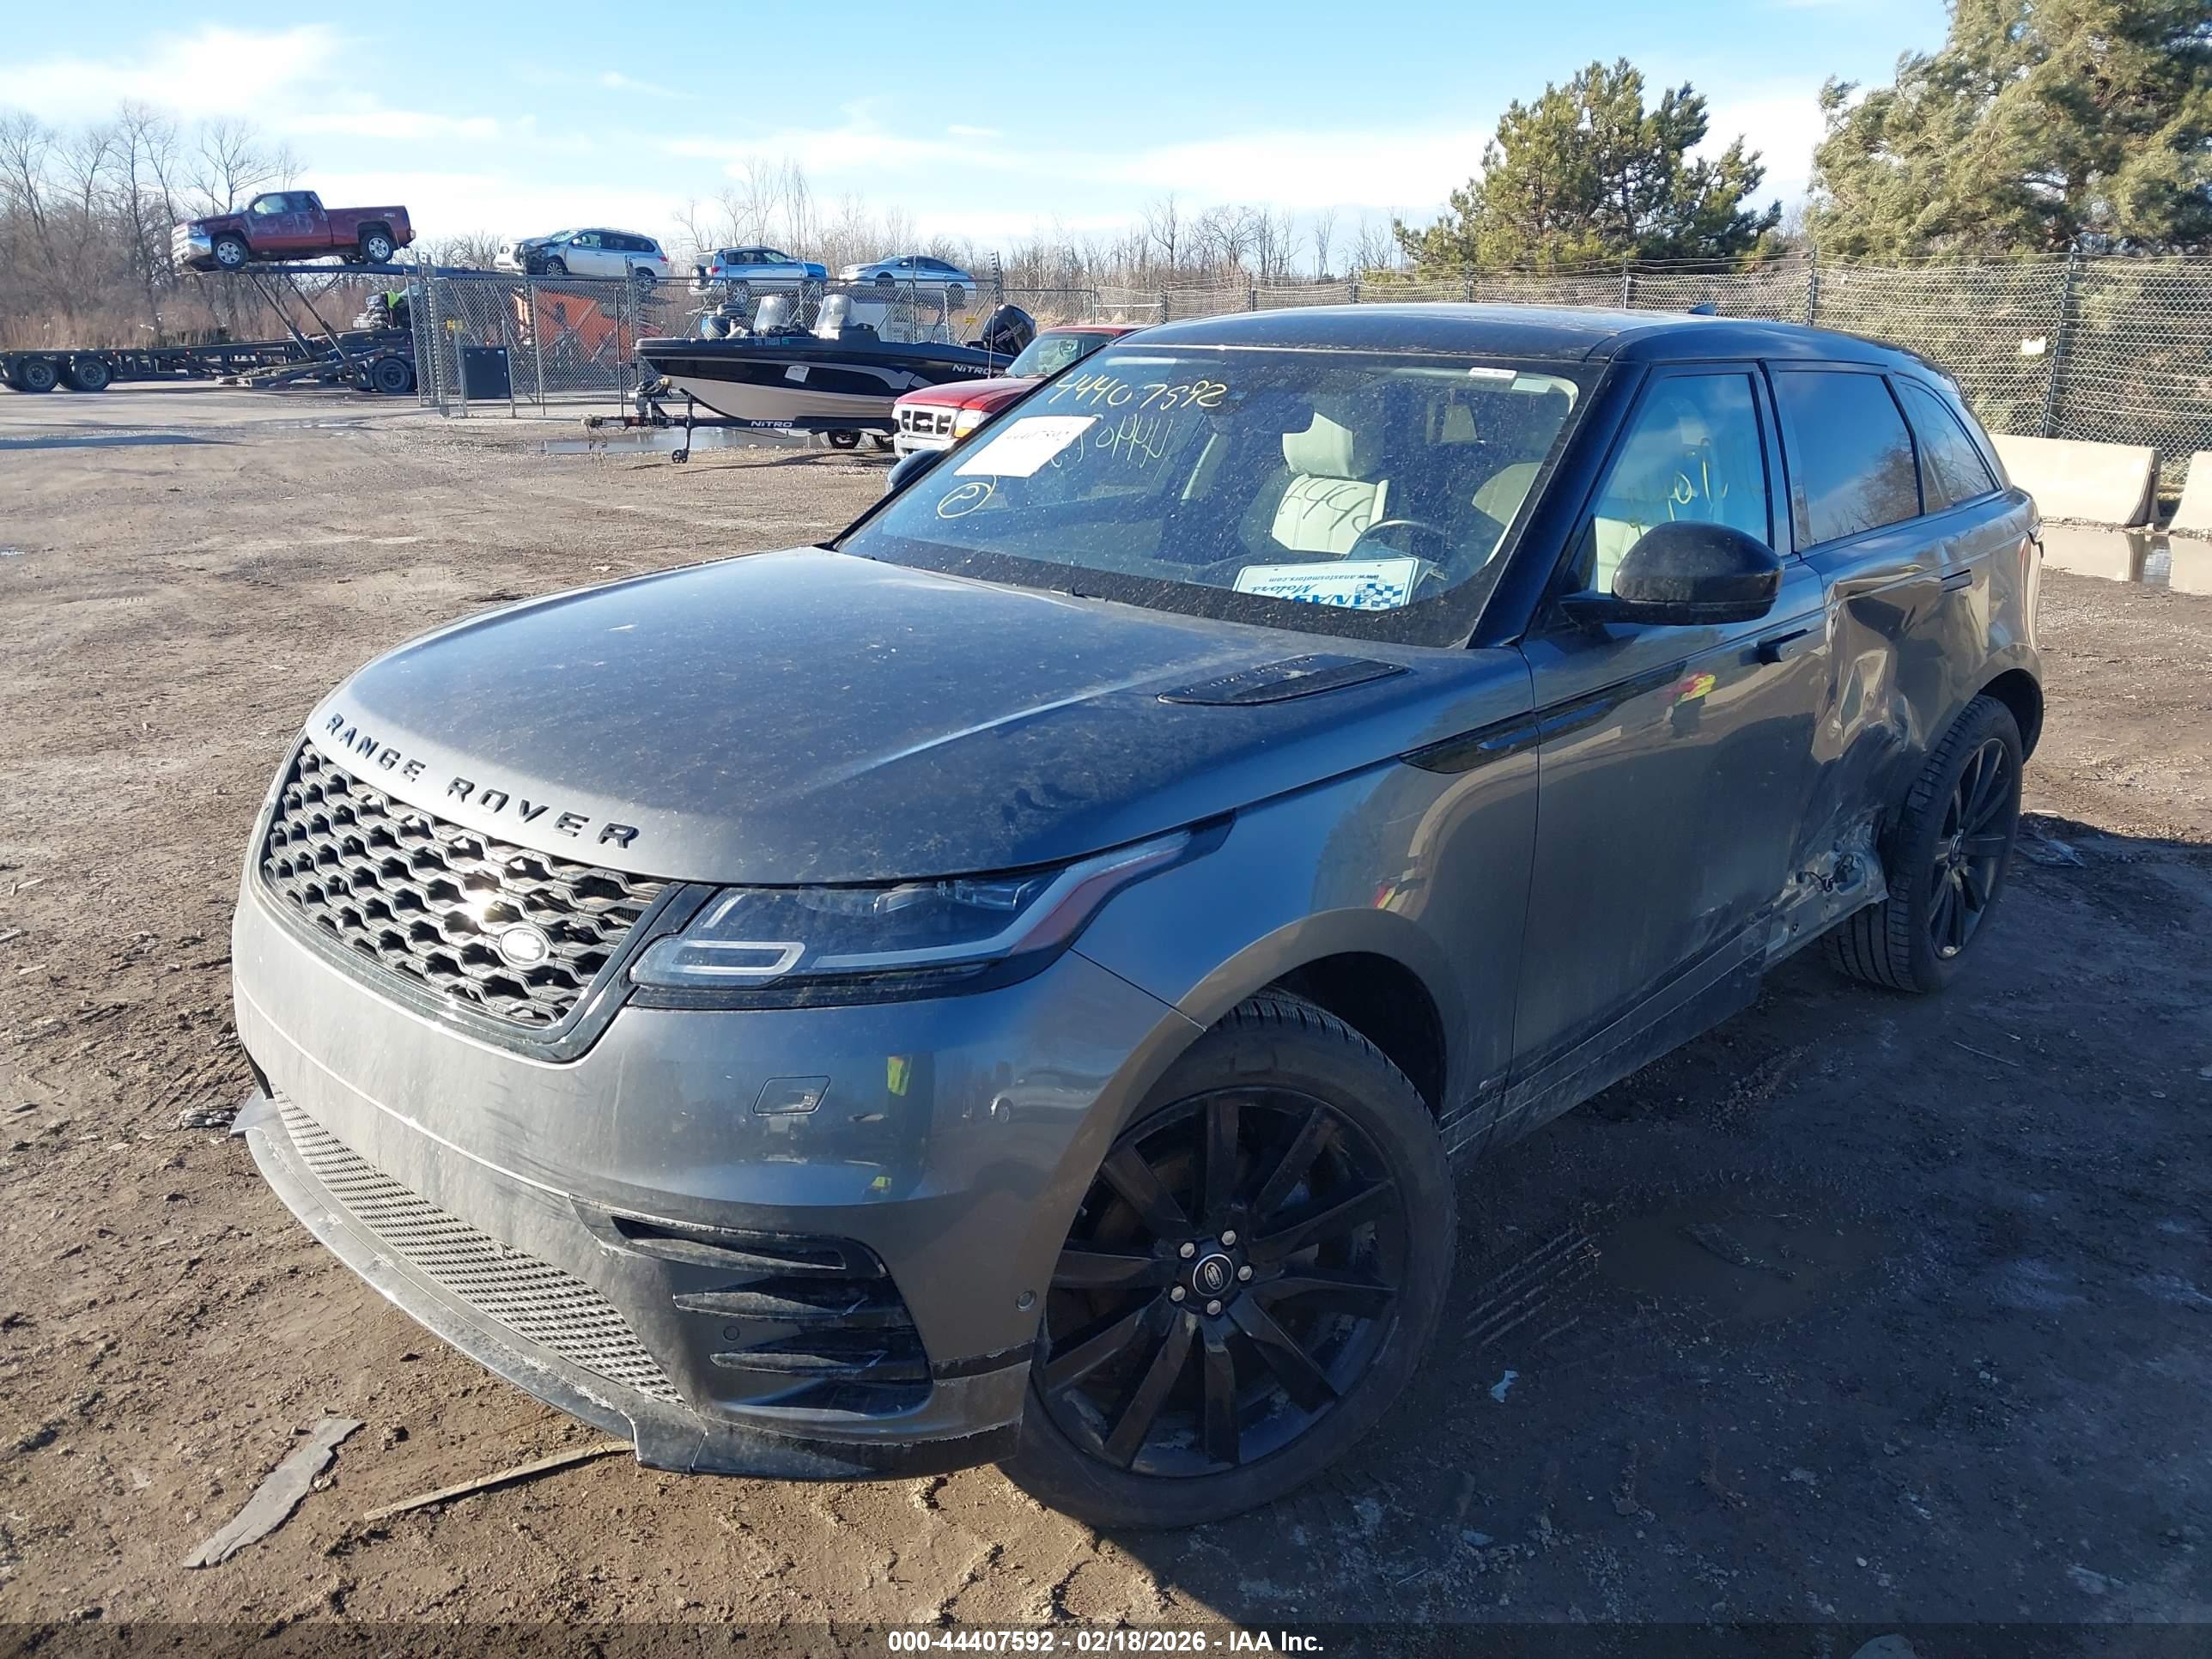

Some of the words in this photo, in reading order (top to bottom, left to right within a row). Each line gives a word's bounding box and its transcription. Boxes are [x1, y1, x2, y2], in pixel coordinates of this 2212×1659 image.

[1250, 583, 1318, 594] Motors
[325, 713, 427, 782] RANGE
[445, 775, 641, 849] ROVER
